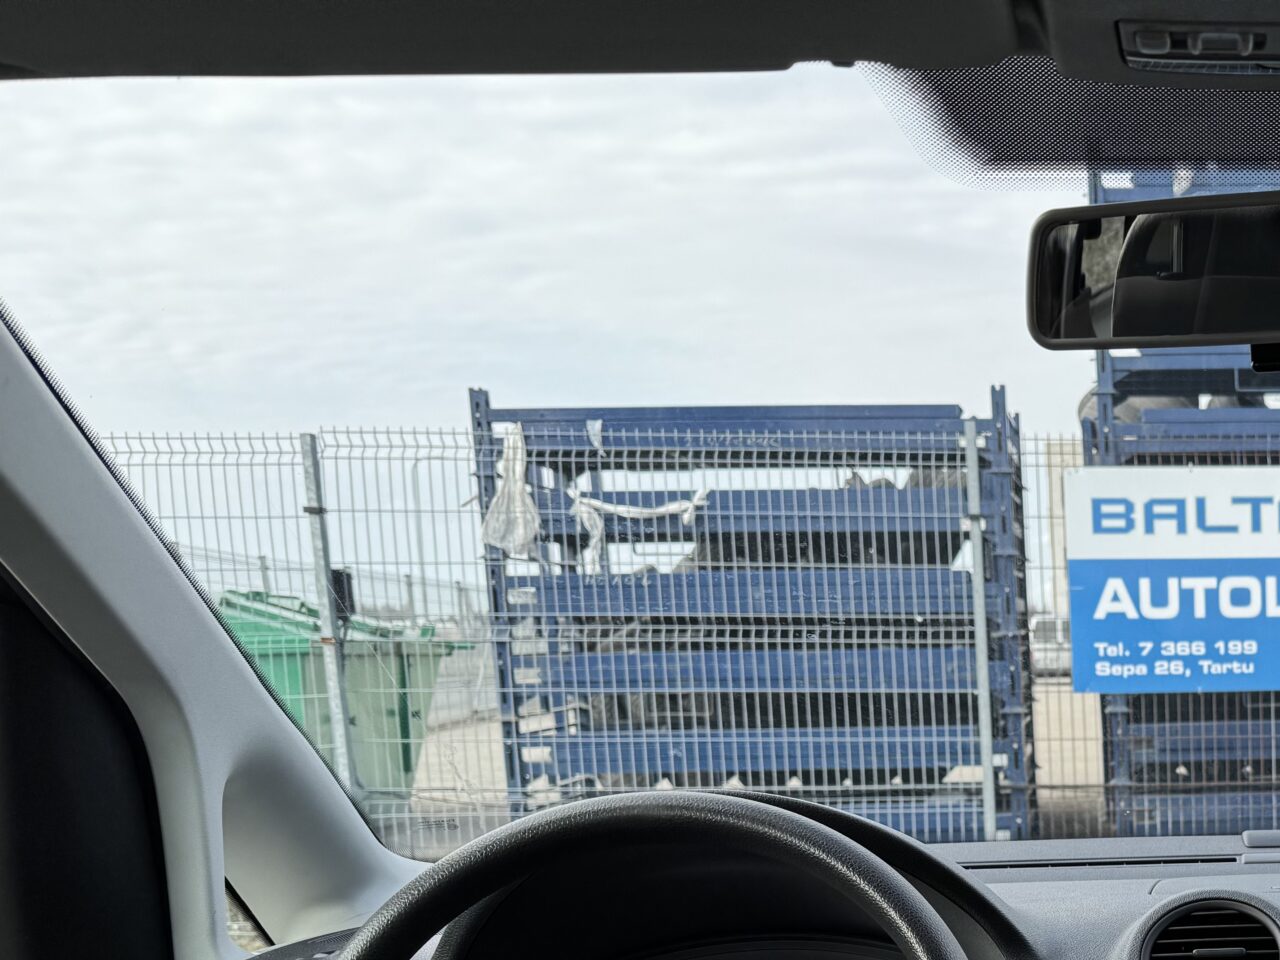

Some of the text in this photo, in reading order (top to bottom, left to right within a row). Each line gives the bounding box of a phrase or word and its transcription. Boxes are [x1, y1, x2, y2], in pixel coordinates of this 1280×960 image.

[1093, 640, 1258, 657] Tel. 7 366 199
[1094, 659, 1255, 679] Sepa 26, Tartu
